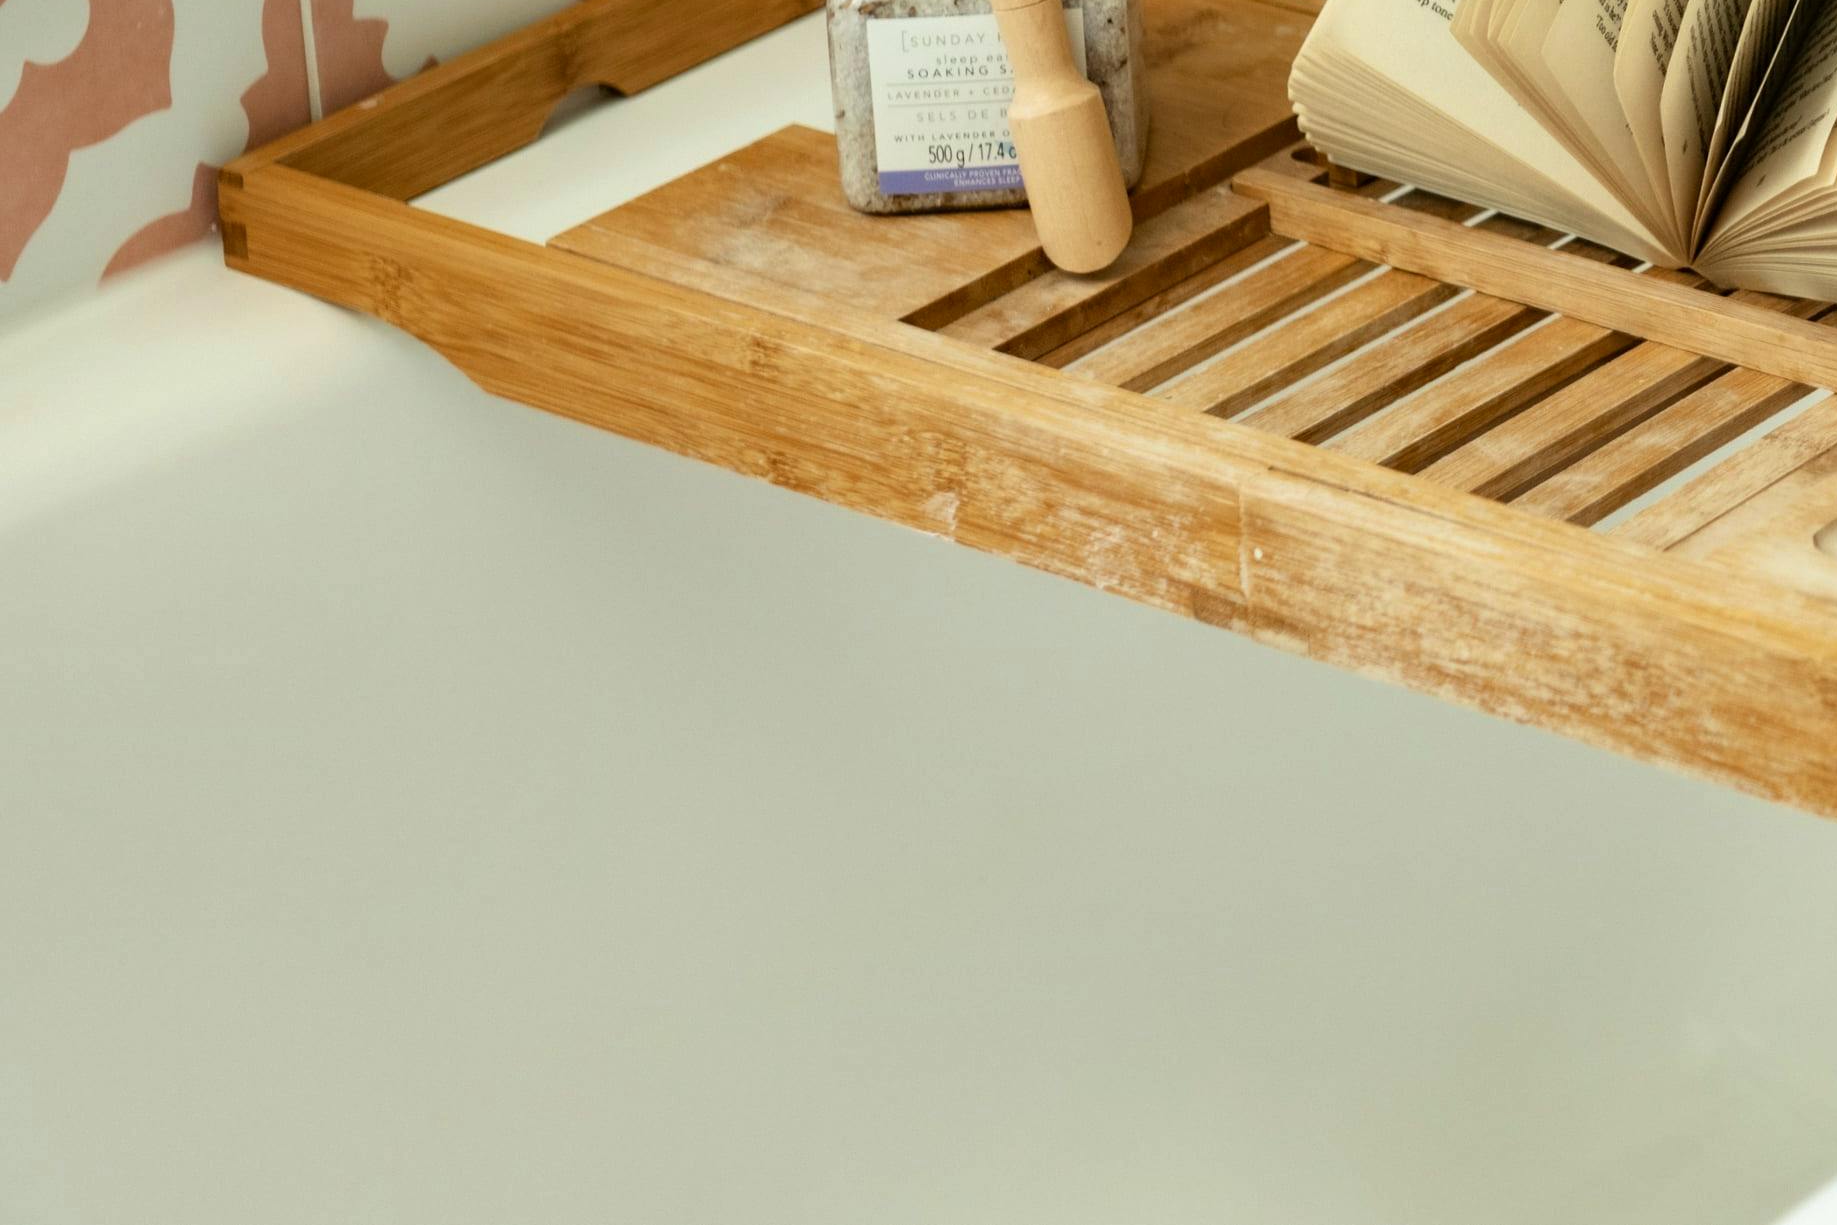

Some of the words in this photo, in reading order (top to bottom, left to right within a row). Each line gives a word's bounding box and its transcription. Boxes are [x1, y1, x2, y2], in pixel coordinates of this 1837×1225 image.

[936, 54, 978, 66] sleep
[907, 64, 989, 80] SOAKING
[888, 87, 959, 101] LAVENDER
[917, 110, 957, 123] SELS
[967, 108, 989, 121] DE
[894, 134, 925, 143] WITH
[932, 130, 996, 141] LAVENDER
[928, 144, 953, 164] 500
[956, 149, 965, 168] g
[979, 141, 1005, 161] 17.4
